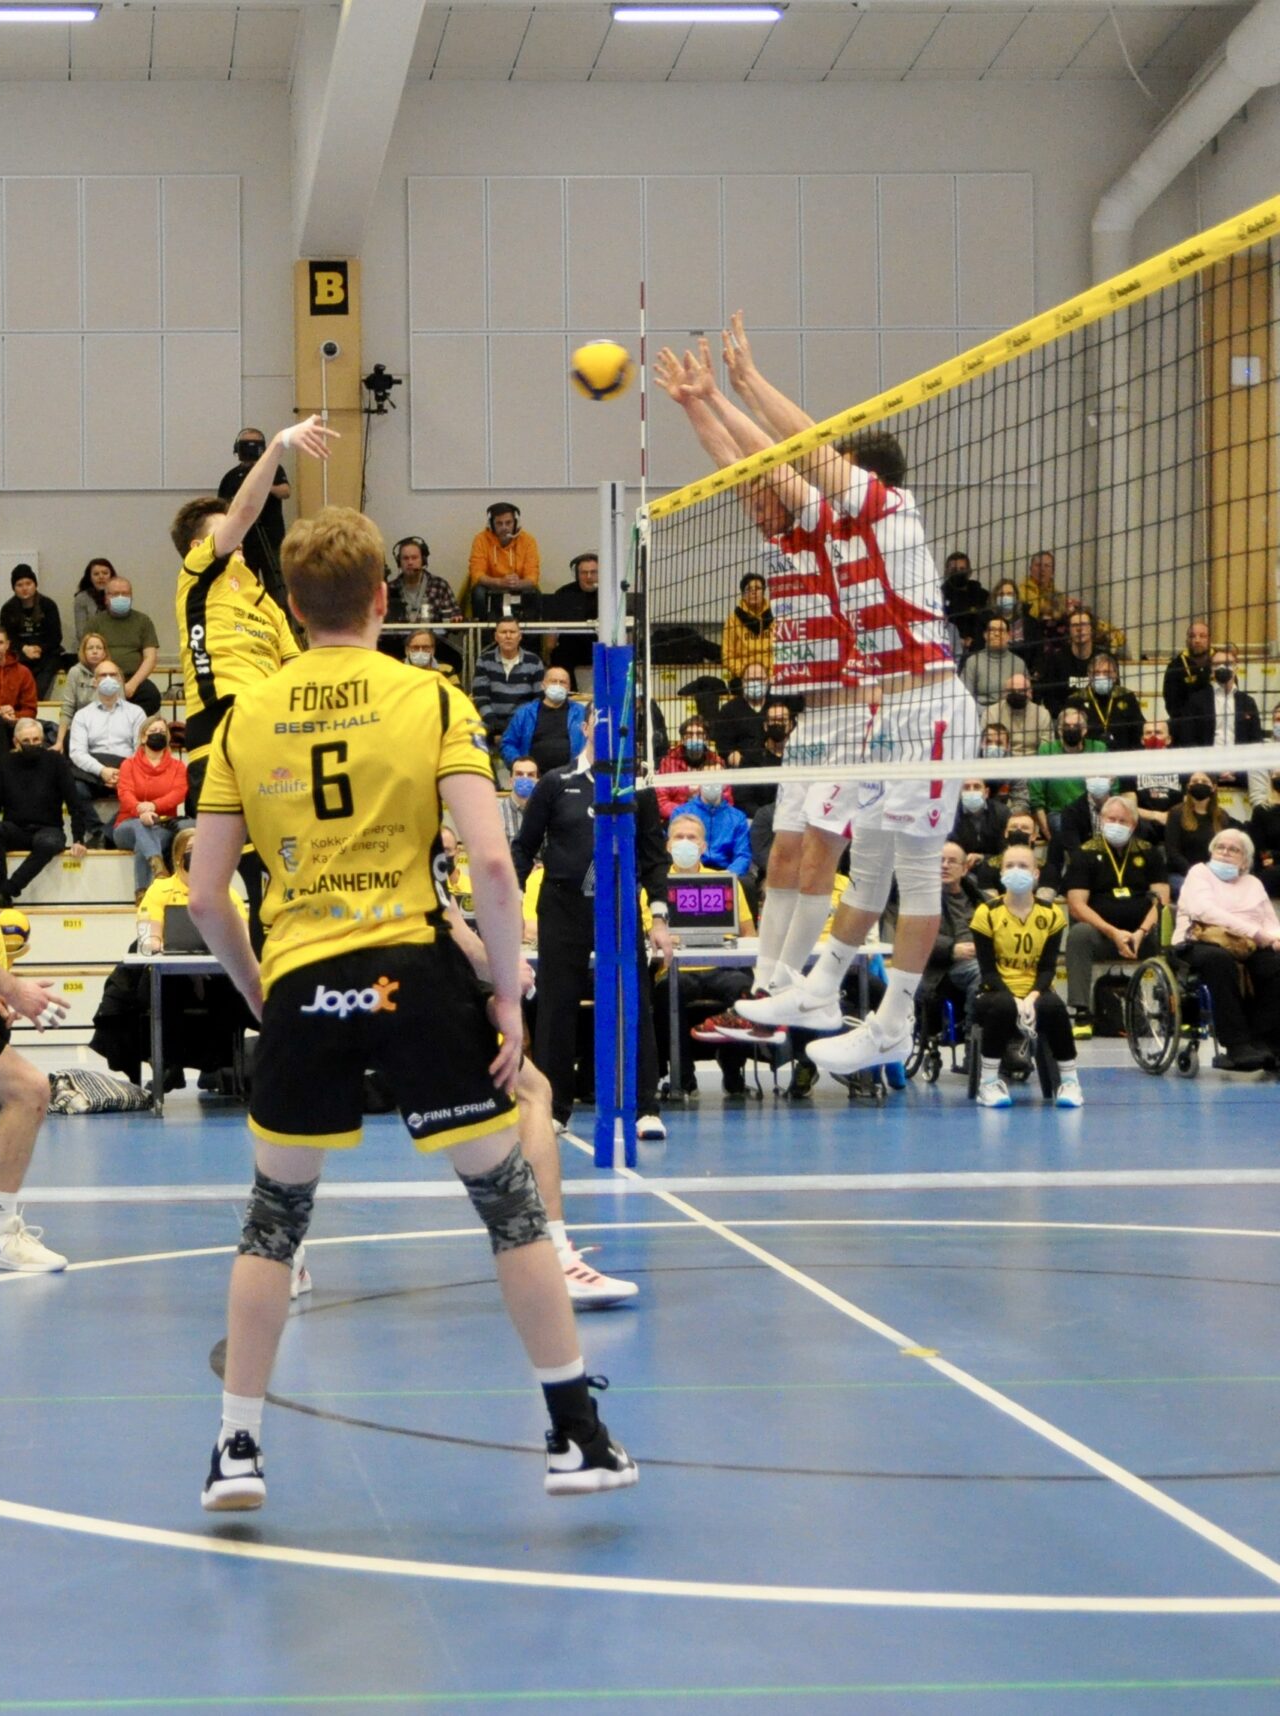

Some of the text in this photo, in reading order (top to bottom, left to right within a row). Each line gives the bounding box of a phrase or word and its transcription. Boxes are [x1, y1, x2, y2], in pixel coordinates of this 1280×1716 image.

[314, 271, 345, 305] B
[289, 679, 369, 712] FÖRSTI
[274, 711, 381, 734] BEST-HALL
[311, 740, 354, 820] 6
[679, 894, 722, 909] 23 22
[1014, 932, 1033, 954] 70
[423, 1098, 496, 1122] FINN SPRING
